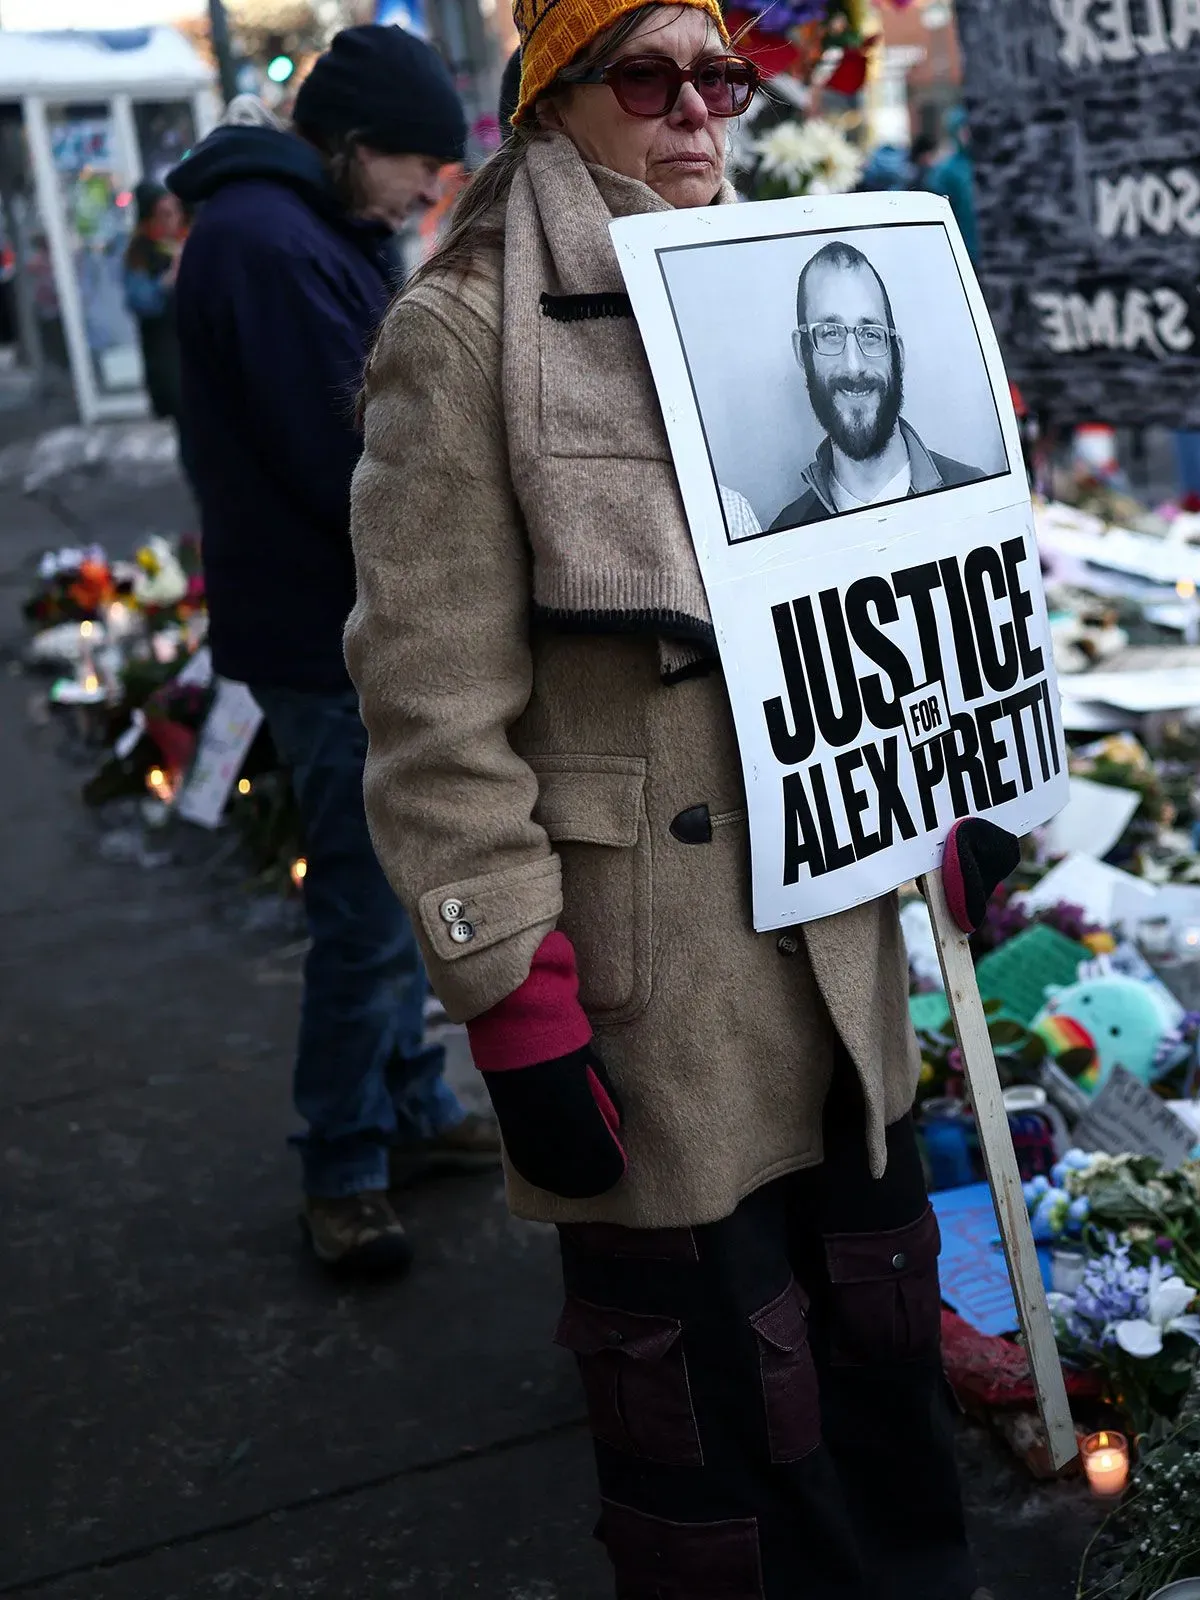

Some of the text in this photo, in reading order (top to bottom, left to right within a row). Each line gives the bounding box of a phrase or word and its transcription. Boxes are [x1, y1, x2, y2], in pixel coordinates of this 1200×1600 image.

[762, 536, 1044, 765] JUSTICE
[909, 694, 943, 737] FOR
[782, 679, 1060, 886] ALEX PRETTI
